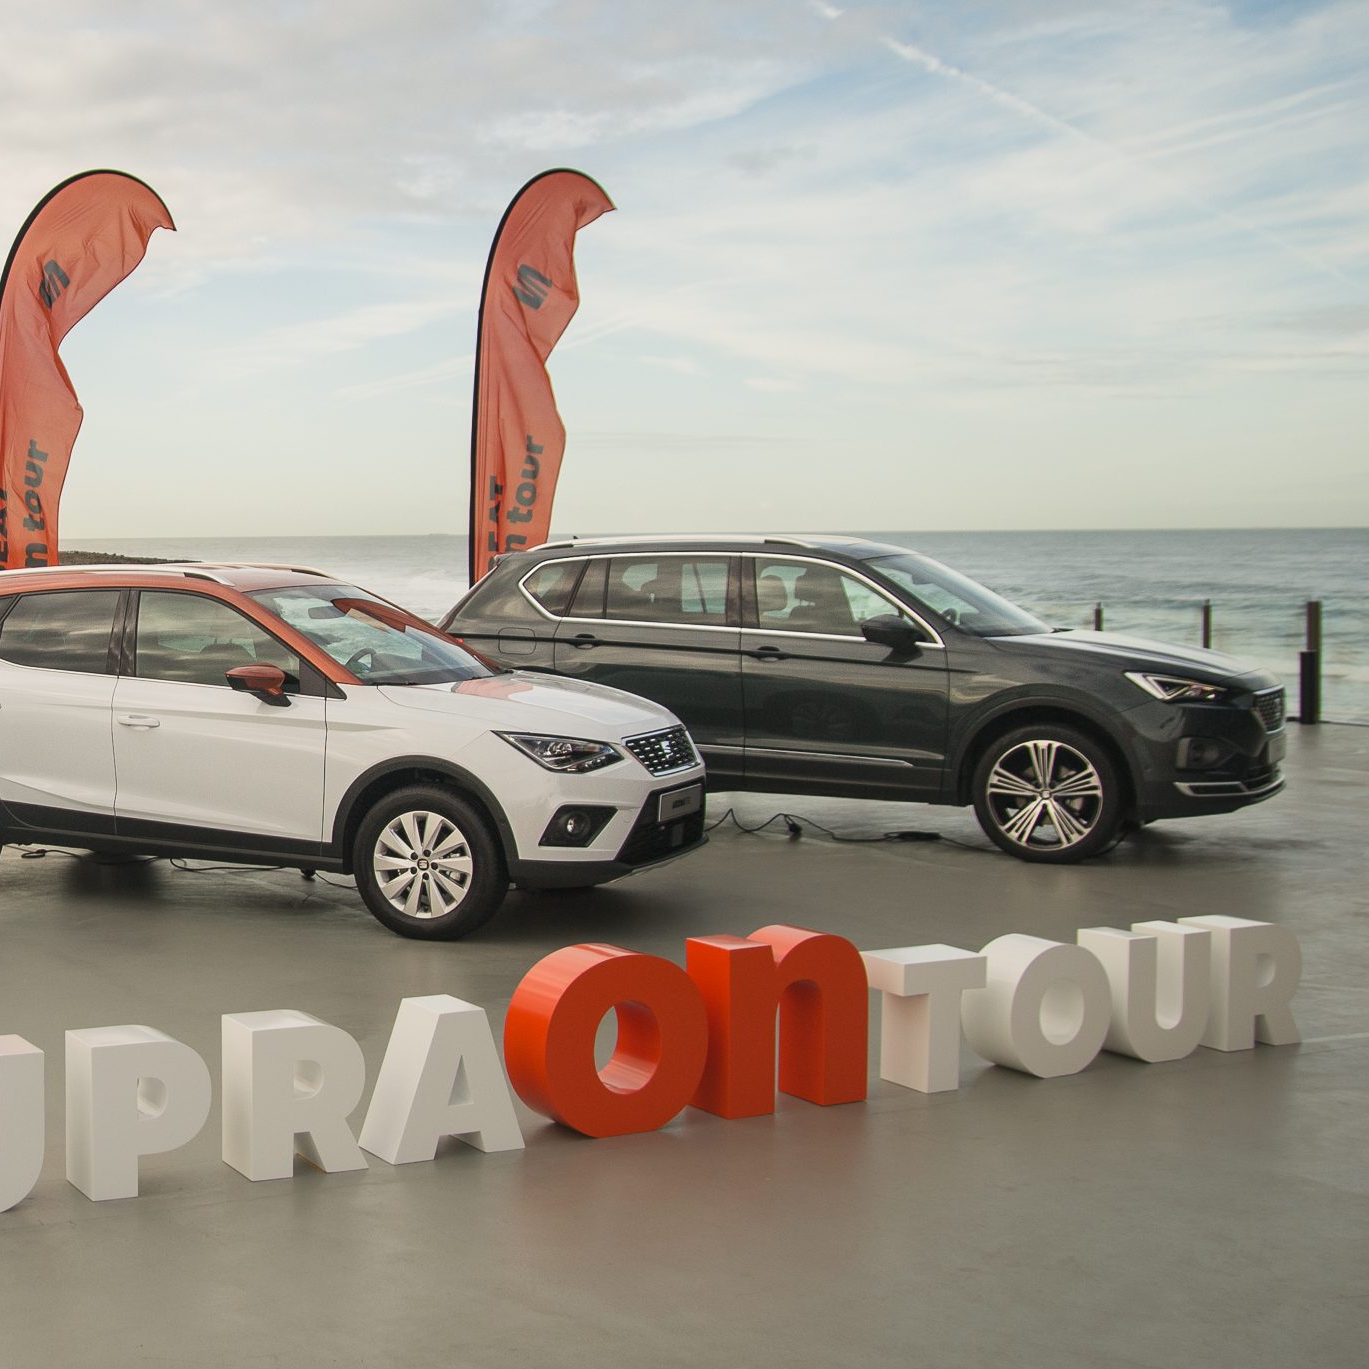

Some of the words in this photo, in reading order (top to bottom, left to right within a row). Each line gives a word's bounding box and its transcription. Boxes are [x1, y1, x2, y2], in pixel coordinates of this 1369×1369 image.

[23, 439, 48, 531] tour
[507, 435, 544, 523] tour
[504, 924, 869, 1139] on
[859, 914, 1303, 1094] TOUR
